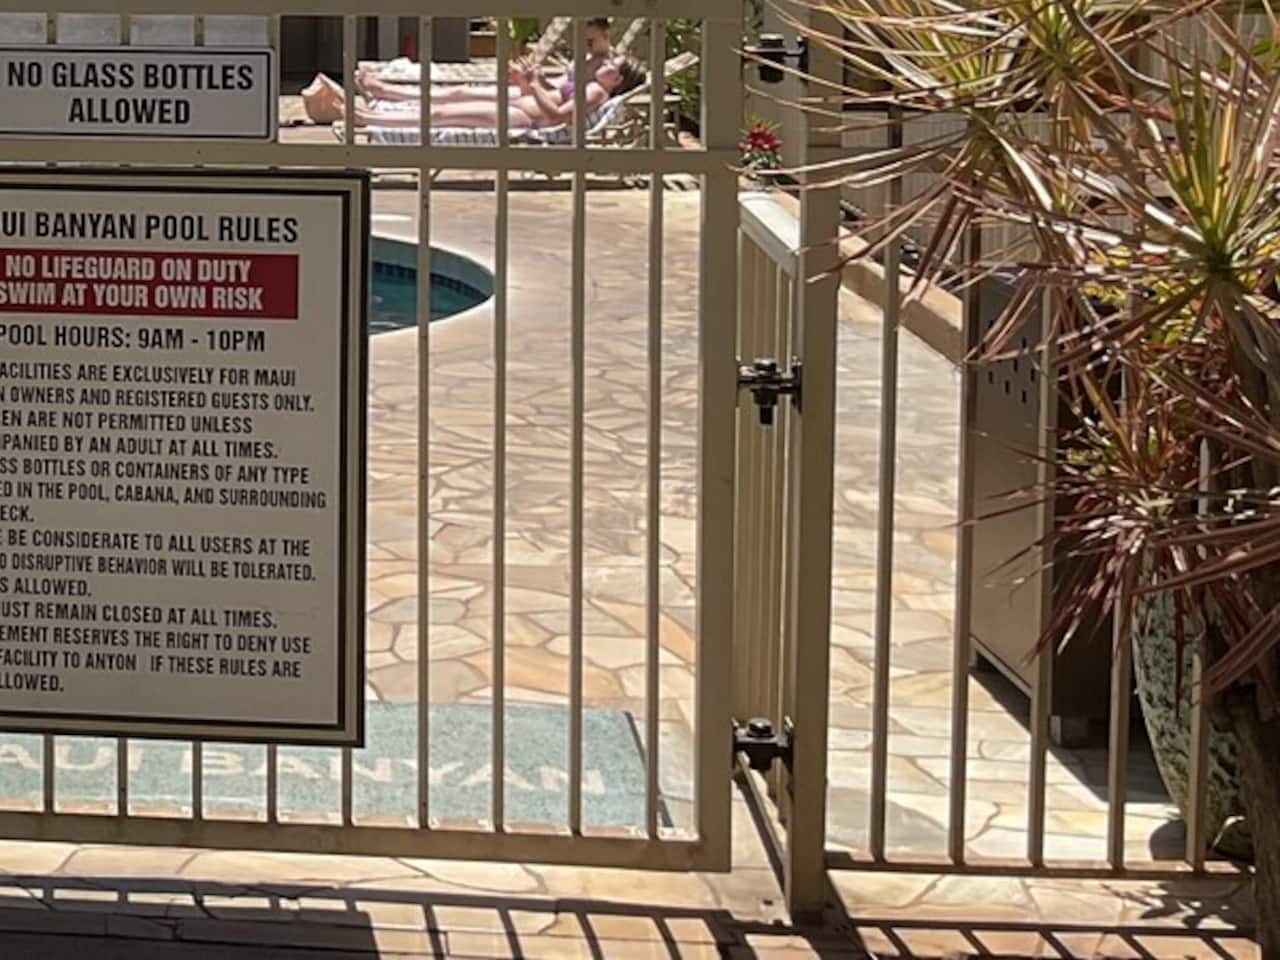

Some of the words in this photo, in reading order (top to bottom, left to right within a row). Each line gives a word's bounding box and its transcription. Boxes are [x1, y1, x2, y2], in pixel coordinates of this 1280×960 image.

[8, 62, 42, 87] NO
[52, 62, 135, 89] GLASS
[143, 64, 253, 90] BOTTLES
[69, 98, 190, 124] ALLOWED
[35, 212, 136, 239] BANYAN
[145, 215, 209, 241] POOL
[218, 216, 298, 243] RULES
[6, 255, 35, 277] NO
[42, 256, 155, 280] LIFEGUARD
[161, 258, 191, 281] ON
[198, 259, 251, 282] DUTY
[61, 283, 88, 305] AT
[93, 284, 148, 307] YOUR
[155, 285, 206, 308] OWN
[213, 287, 262, 310] RISK
[138, 328, 183, 349] 9AM
[207, 330, 264, 352] 10PM
[77, 364, 107, 382] ARE
[113, 365, 214, 384] EXCLUSIVELY
[220, 368, 249, 386] FOR
[254, 369, 295, 386] MAUI
[10, 386, 75, 404] OWNERS
[80, 388, 111, 405] AND
[115, 389, 207, 408] REGISTERED
[211, 392, 269, 410] GUESTS
[27, 410, 57, 427] ARE
[63, 412, 93, 429] NOT
[98, 413, 186, 431] PERMITTED
[191, 416, 252, 433] UNLESS
[64, 436, 83, 452] BY
[88, 437, 111, 453] AN
[116, 438, 163, 455] ADULT
[168, 439, 187, 456] AT
[192, 440, 219, 456] ALL
[23, 458, 86, 476] BOTTLES
[91, 460, 110, 477] OR
[115, 461, 209, 480] CONTAINERS
[215, 465, 232, 481] OF
[237, 466, 267, 482] ANY
[272, 467, 309, 484] TYPE
[17, 482, 32, 498] IN
[37, 482, 64, 499] THE
[184, 487, 214, 504] AND
[219, 488, 326, 508] SURROUNDING
[8, 529, 27, 546] BE
[32, 530, 139, 550] CONSIDERATE
[144, 534, 163, 551] TO
[168, 535, 196, 552] ALL
[200, 536, 253, 554] USERS
[258, 539, 277, 555] AT
[282, 539, 310, 556] THE
[12, 553, 93, 572] DISRUPTIVE
[98, 556, 167, 575] BEHAVIOR
[172, 559, 206, 577] WILL
[211, 561, 229, 578] BE
[35, 602, 97, 621] REMAIN
[102, 605, 162, 623] CLOSED
[167, 608, 185, 624] AT
[190, 609, 218, 626] ALL
[53, 627, 129, 646] RESERVES
[133, 630, 161, 648] THE
[166, 632, 209, 650] RIGHT
[214, 634, 232, 650] TO
[237, 635, 277, 652] DENY
[282, 637, 310, 653] USE
[62, 651, 80, 668] TO
[151, 655, 163, 672] IF
[168, 656, 214, 674] THESE
[220, 658, 267, 676] RULES
[272, 661, 300, 678] ARE
